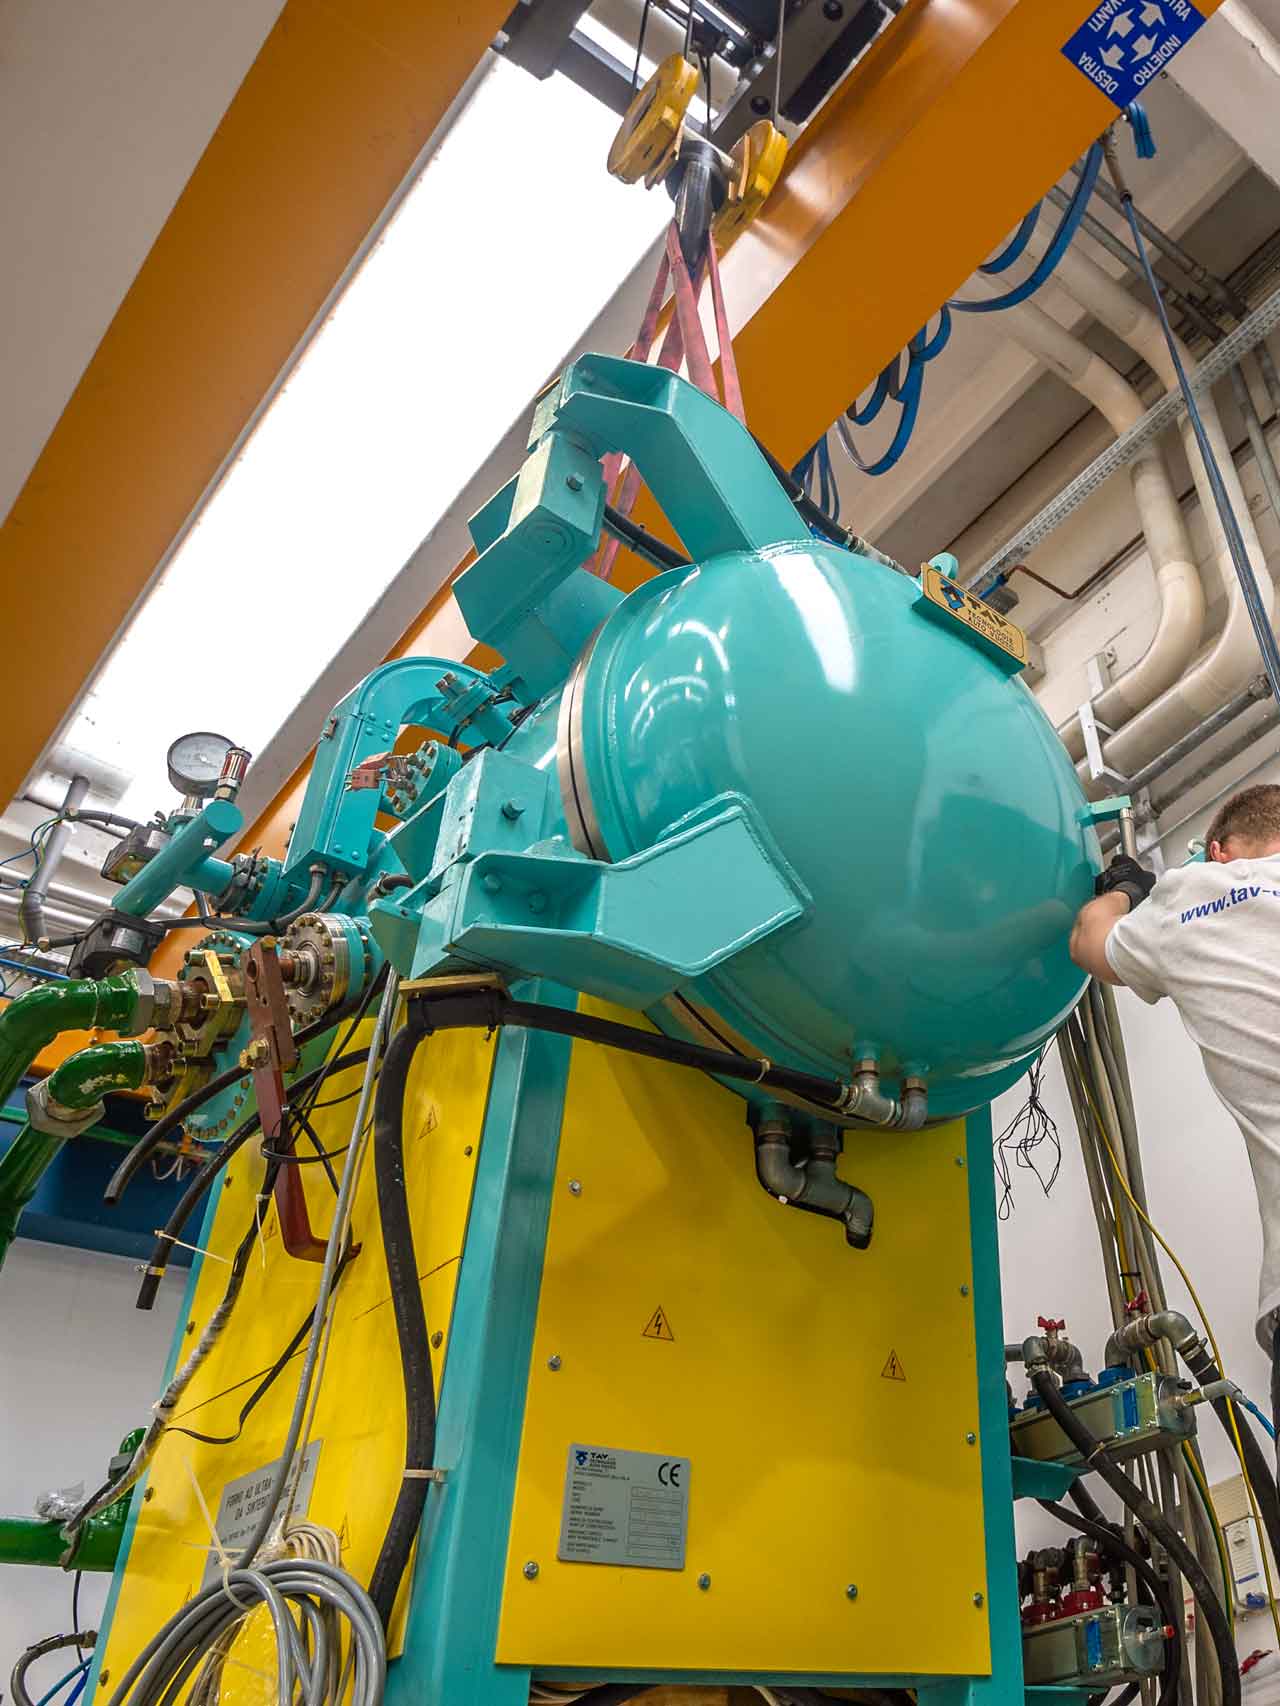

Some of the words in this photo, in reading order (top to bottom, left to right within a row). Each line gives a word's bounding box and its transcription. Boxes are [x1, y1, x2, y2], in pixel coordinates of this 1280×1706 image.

[1087, 0, 1127, 32] VANTI
[1077, 51, 1119, 95] DESTRA
[1133, 34, 1182, 87] INDIETRO
[966, 595, 1008, 628] TAV
[658, 1462, 681, 1487] CE
